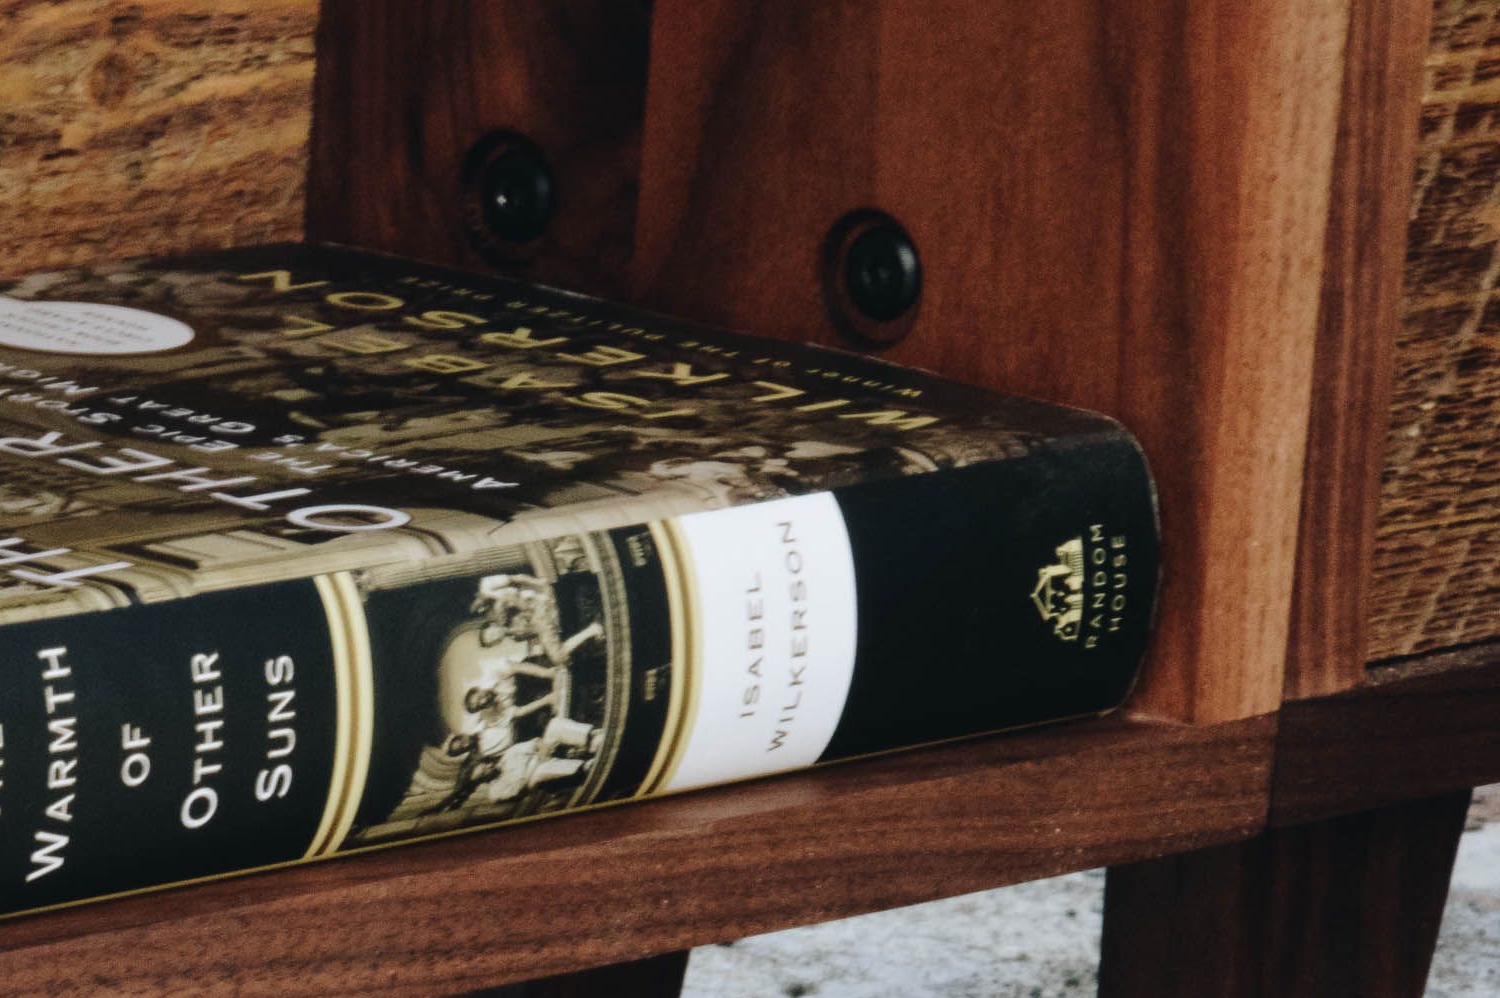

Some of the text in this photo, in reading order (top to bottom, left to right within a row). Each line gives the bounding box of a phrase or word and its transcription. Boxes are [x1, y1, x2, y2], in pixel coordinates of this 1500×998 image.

[236, 270, 940, 430] WILKERSON
[282, 315, 697, 419] ISABEL
[108, 396, 256, 434] GREAT
[130, 424, 240, 452] EPIC
[249, 451, 332, 474] THE
[272, 434, 520, 489] AMERICA'S
[765, 521, 808, 752] WILKERSON
[1085, 524, 1108, 649] RANDOM
[1108, 535, 1127, 631] HOUSE
[739, 571, 764, 718] ISABEL
[25, 646, 77, 882] WARMTH
[120, 723, 151, 787] OF
[180, 652, 224, 829] OTHER
[255, 655, 296, 801] SUNS
